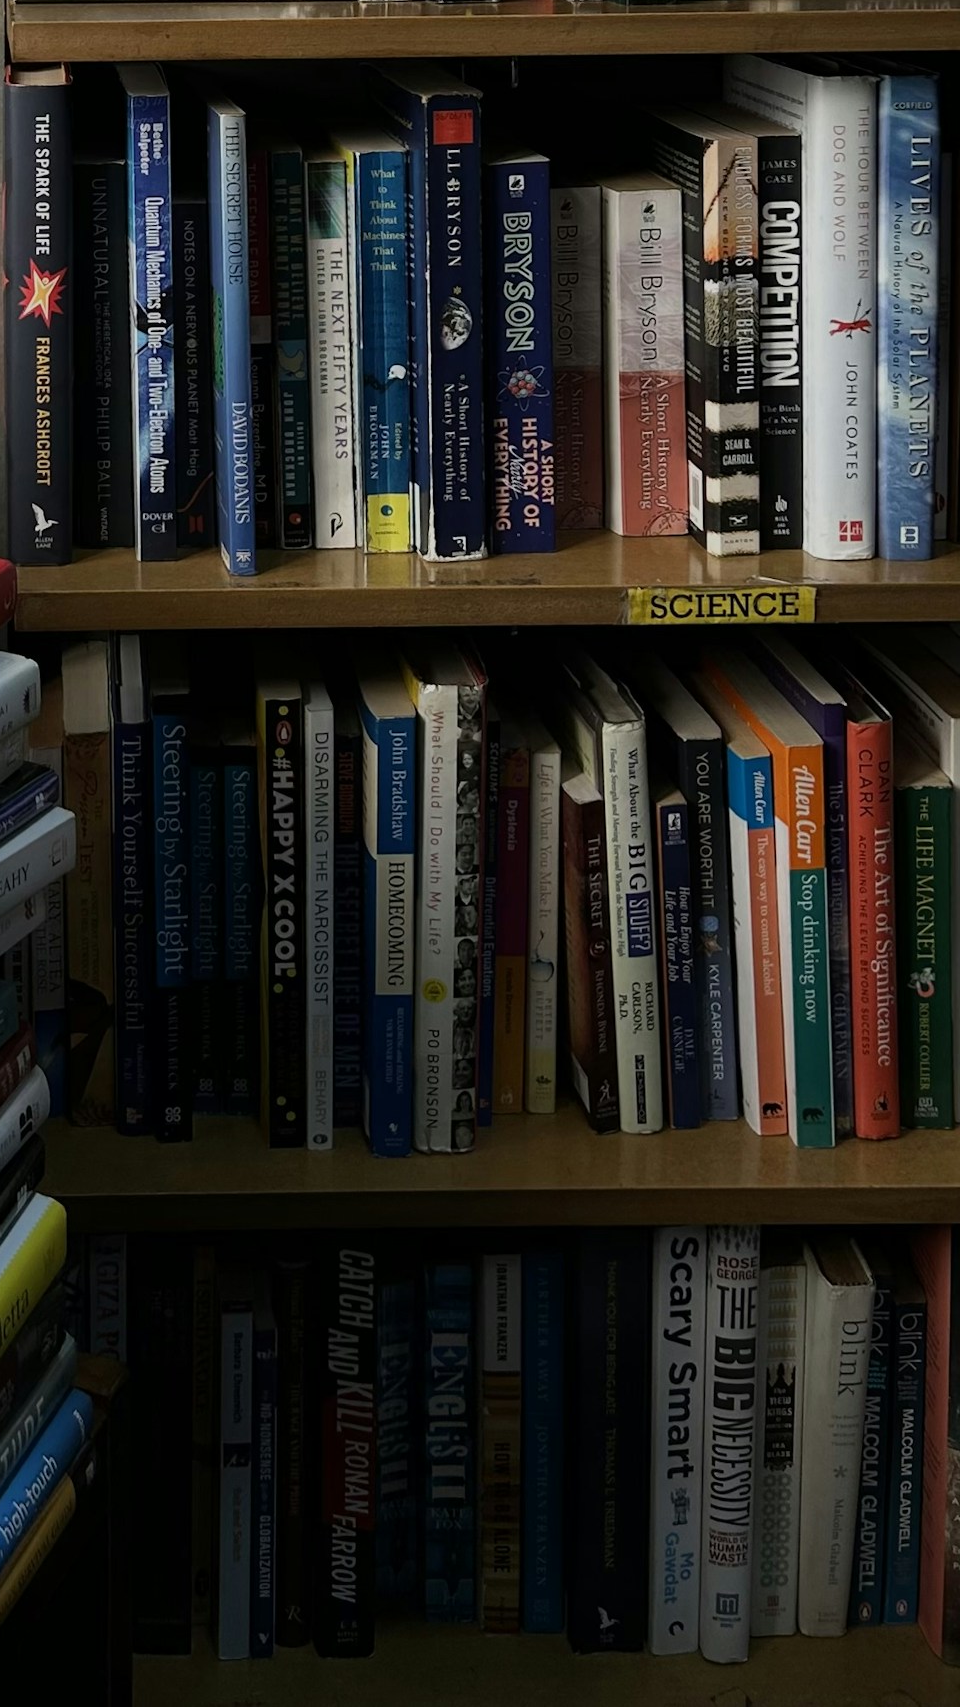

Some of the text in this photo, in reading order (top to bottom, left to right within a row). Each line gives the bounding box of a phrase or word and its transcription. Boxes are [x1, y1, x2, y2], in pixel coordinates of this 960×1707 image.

[893, 100, 932, 110] CORFIELD
[35, 115, 50, 256] THE SPARK OF LIFE
[503, 211, 534, 353] BRYSON
[640, 227, 663, 362] Bill Bryson
[761, 201, 801, 388] COMPETITION
[909, 135, 932, 479] LIVES of the PLANETS
[36, 337, 51, 487] FRANCES ASHCROFT
[845, 362, 858, 480] JOHN COATES
[649, 593, 800, 619] SCIENCE
[390, 730, 407, 841] John Bradshaw
[792, 765, 817, 863] Allen Carr
[858, 750, 875, 818] CLARK
[877, 761, 889, 802] DAN
[271, 758, 296, 975] #HAPPY X COOL
[312, 732, 329, 1004] DISARMING THE NARCISSIST
[388, 862, 405, 987] HOMECOMING
[802, 875, 817, 1023] Stop drinking now
[870, 822, 891, 1067] The Art of Significance
[427, 1030, 439, 1129] PO BRONSON
[716, 1269, 758, 1279] GEORGE
[717, 1256, 758, 1267] ROSE
[717, 1285, 757, 1329] THE
[662, 1237, 699, 1479] Scary Smart
[713, 1337, 756, 1410] BIG
[0, 1454, 58, 1542] high-touch
[709, 1415, 753, 1526] NECESSITY
[859, 1396, 881, 1592] MALCOLM GLADWELL
